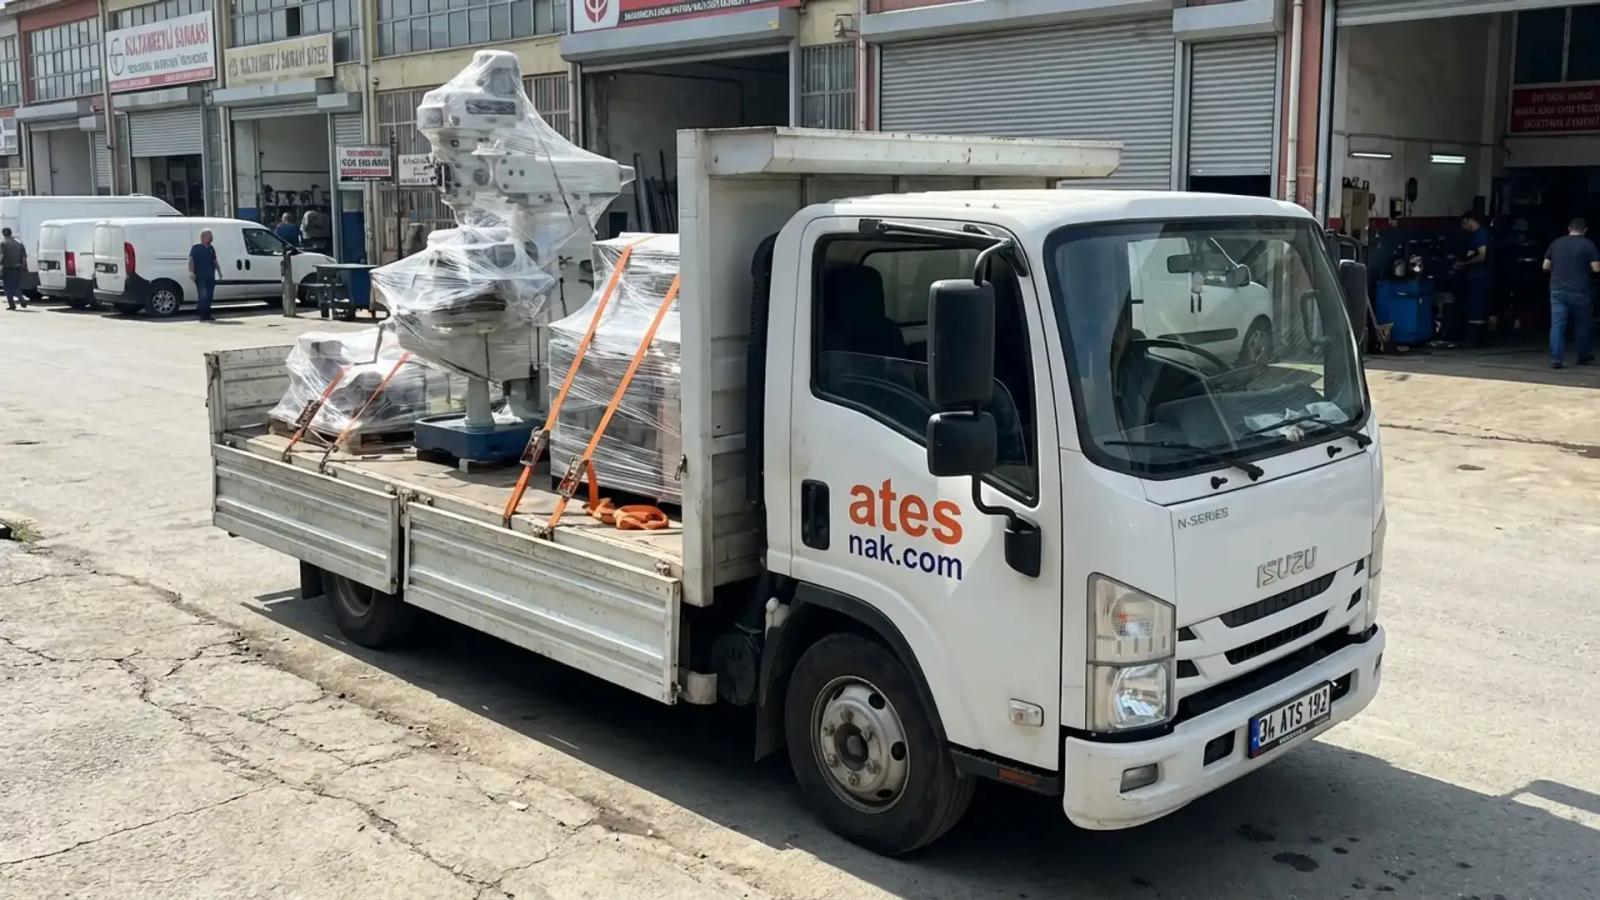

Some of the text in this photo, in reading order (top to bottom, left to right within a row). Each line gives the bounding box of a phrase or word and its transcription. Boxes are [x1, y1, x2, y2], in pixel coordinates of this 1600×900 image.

[849, 478, 963, 545] ates
[1177, 507, 1229, 529] N-SERIES
[849, 534, 962, 580] nak.com
[1256, 545, 1317, 588] ISUZU
[1259, 714, 1275, 743] 34
[1280, 701, 1304, 734] ATS
[1308, 688, 1328, 719] 192
